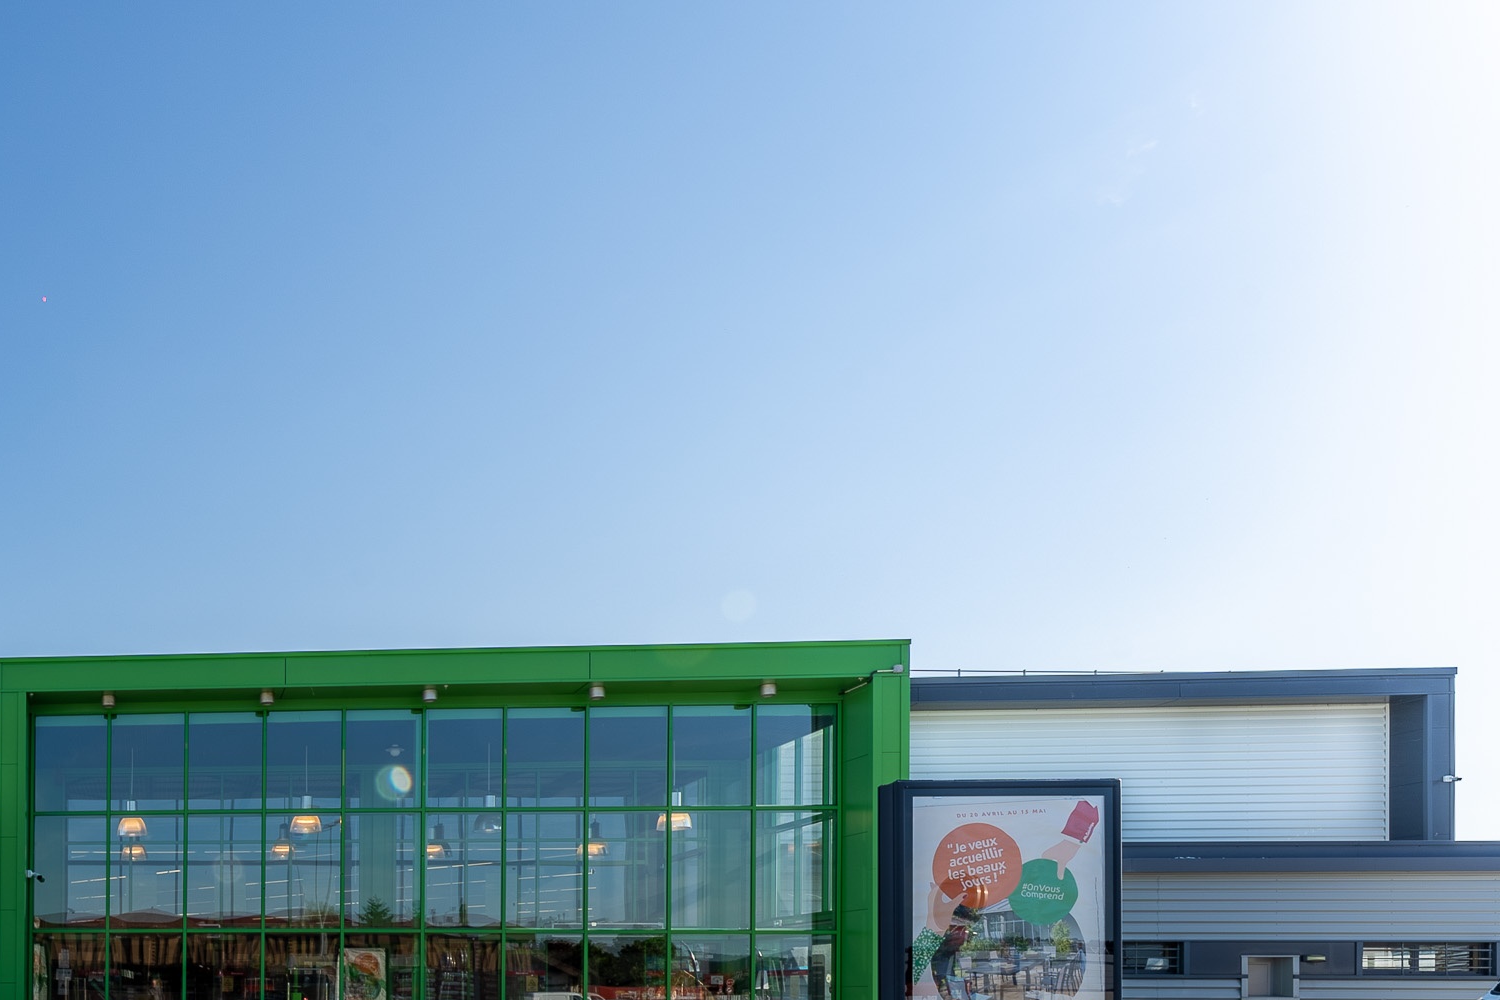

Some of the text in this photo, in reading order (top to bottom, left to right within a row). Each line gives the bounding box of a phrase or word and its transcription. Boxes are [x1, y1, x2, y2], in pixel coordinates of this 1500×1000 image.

[968, 837, 998, 850] veux
[949, 847, 1004, 867] accueillir
[948, 861, 1007, 880] les beaux
[960, 875, 992, 891] jours
[1022, 883, 1060, 893] #OnVous
[1021, 889, 1064, 900] Comprend
